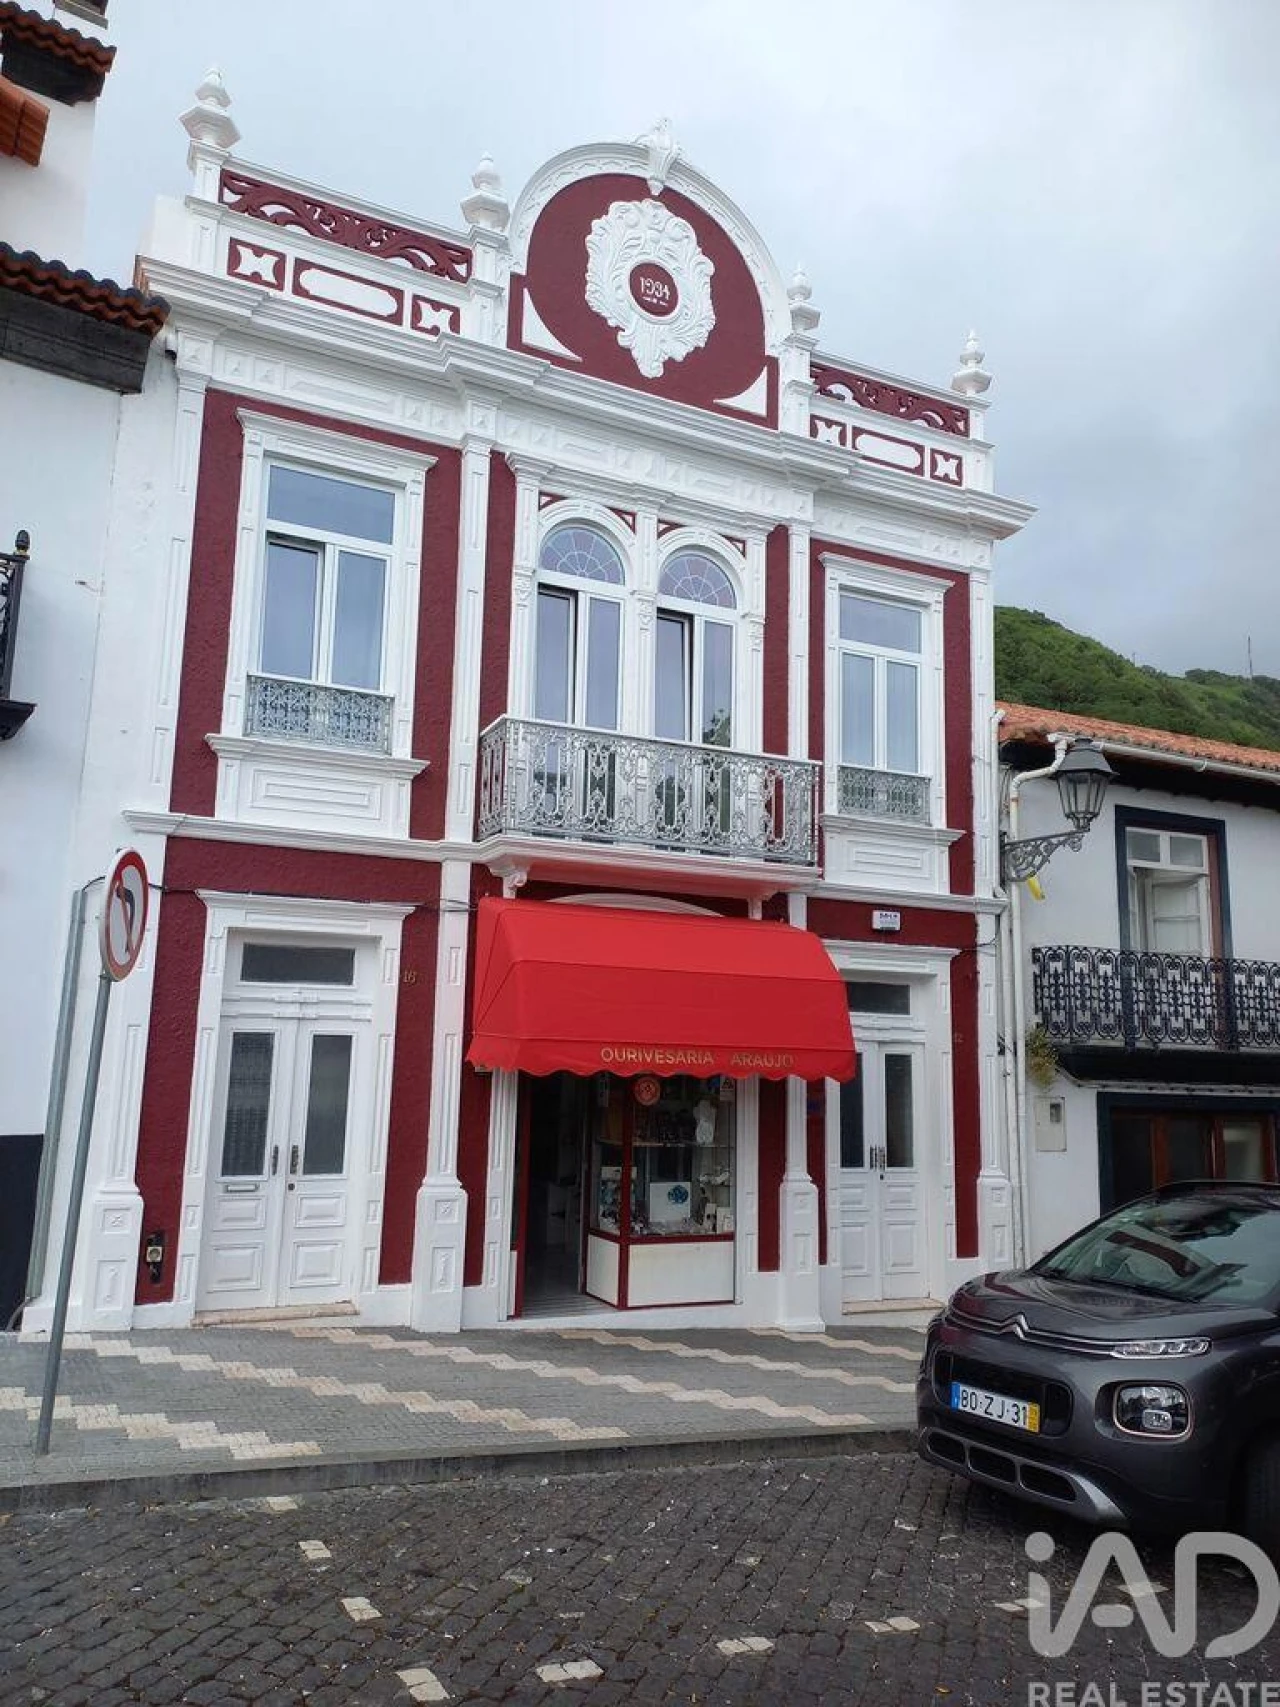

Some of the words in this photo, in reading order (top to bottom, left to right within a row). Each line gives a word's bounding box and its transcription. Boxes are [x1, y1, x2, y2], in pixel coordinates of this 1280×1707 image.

[640, 277, 670, 300] 1934
[600, 1046, 714, 1064] OURIVESARIA
[731, 1052, 795, 1068] ARAUJO
